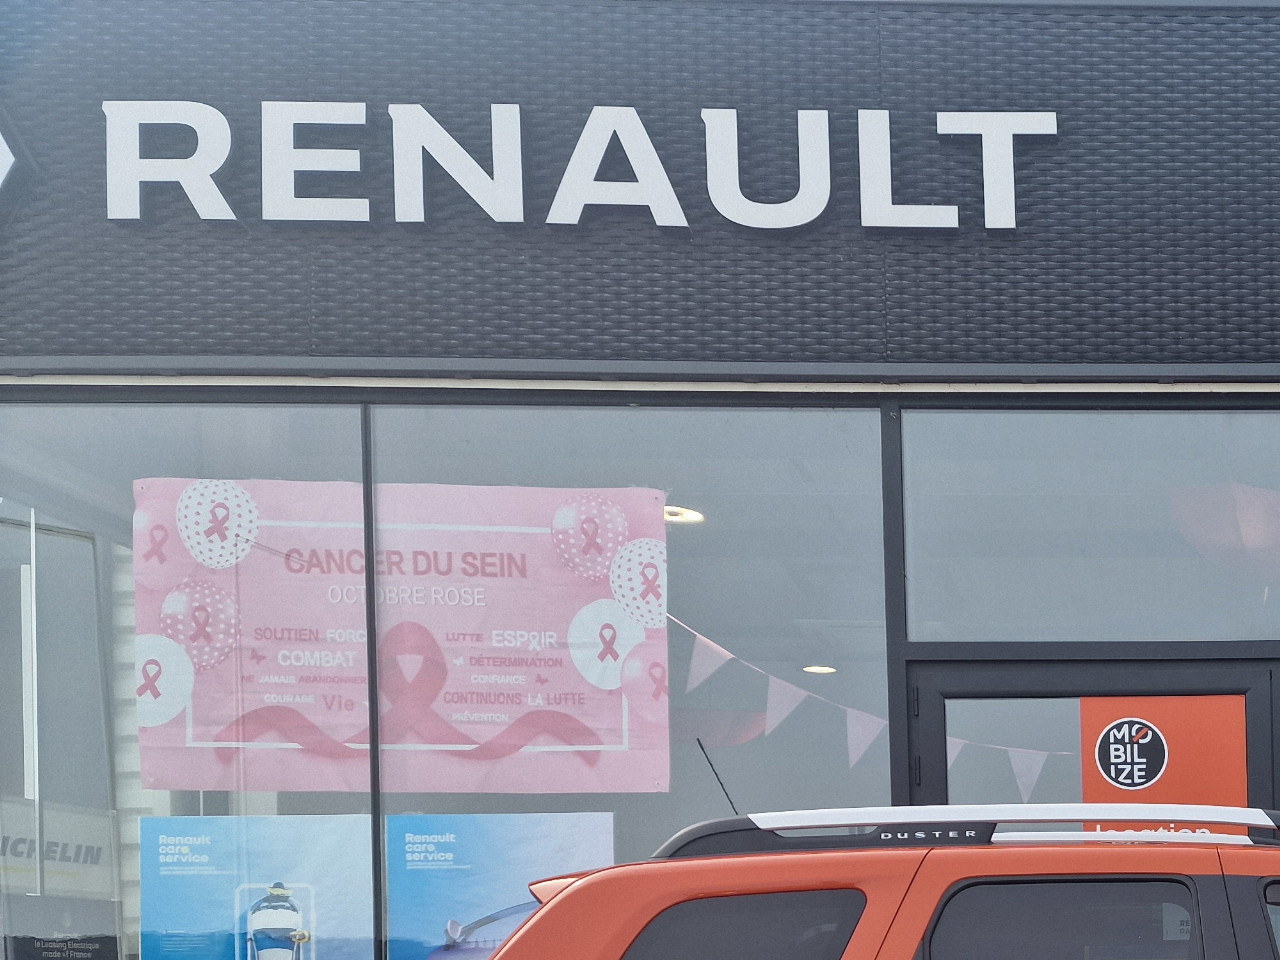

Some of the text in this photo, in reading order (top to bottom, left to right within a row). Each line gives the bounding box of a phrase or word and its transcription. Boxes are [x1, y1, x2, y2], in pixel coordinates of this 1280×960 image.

[101, 100, 1058, 229] RENAULT
[412, 550, 453, 577] DU
[461, 551, 527, 578] SEIN
[431, 587, 486, 607] ROSE
[254, 627, 319, 641] SOUTIEN
[446, 632, 484, 642] LUTTE
[278, 650, 356, 667] COMBAT
[469, 654, 563, 667] DÉTERMINATION
[471, 675, 526, 684] CONFIANCE
[263, 694, 355, 711] COURAGE Vie
[444, 692, 586, 706] CONTINUONS LA LUTTE
[159, 834, 212, 845] Renault
[404, 832, 456, 843] Renault
[880, 830, 976, 840] DUSTER
[159, 853, 209, 863] service
[405, 851, 454, 861] service
